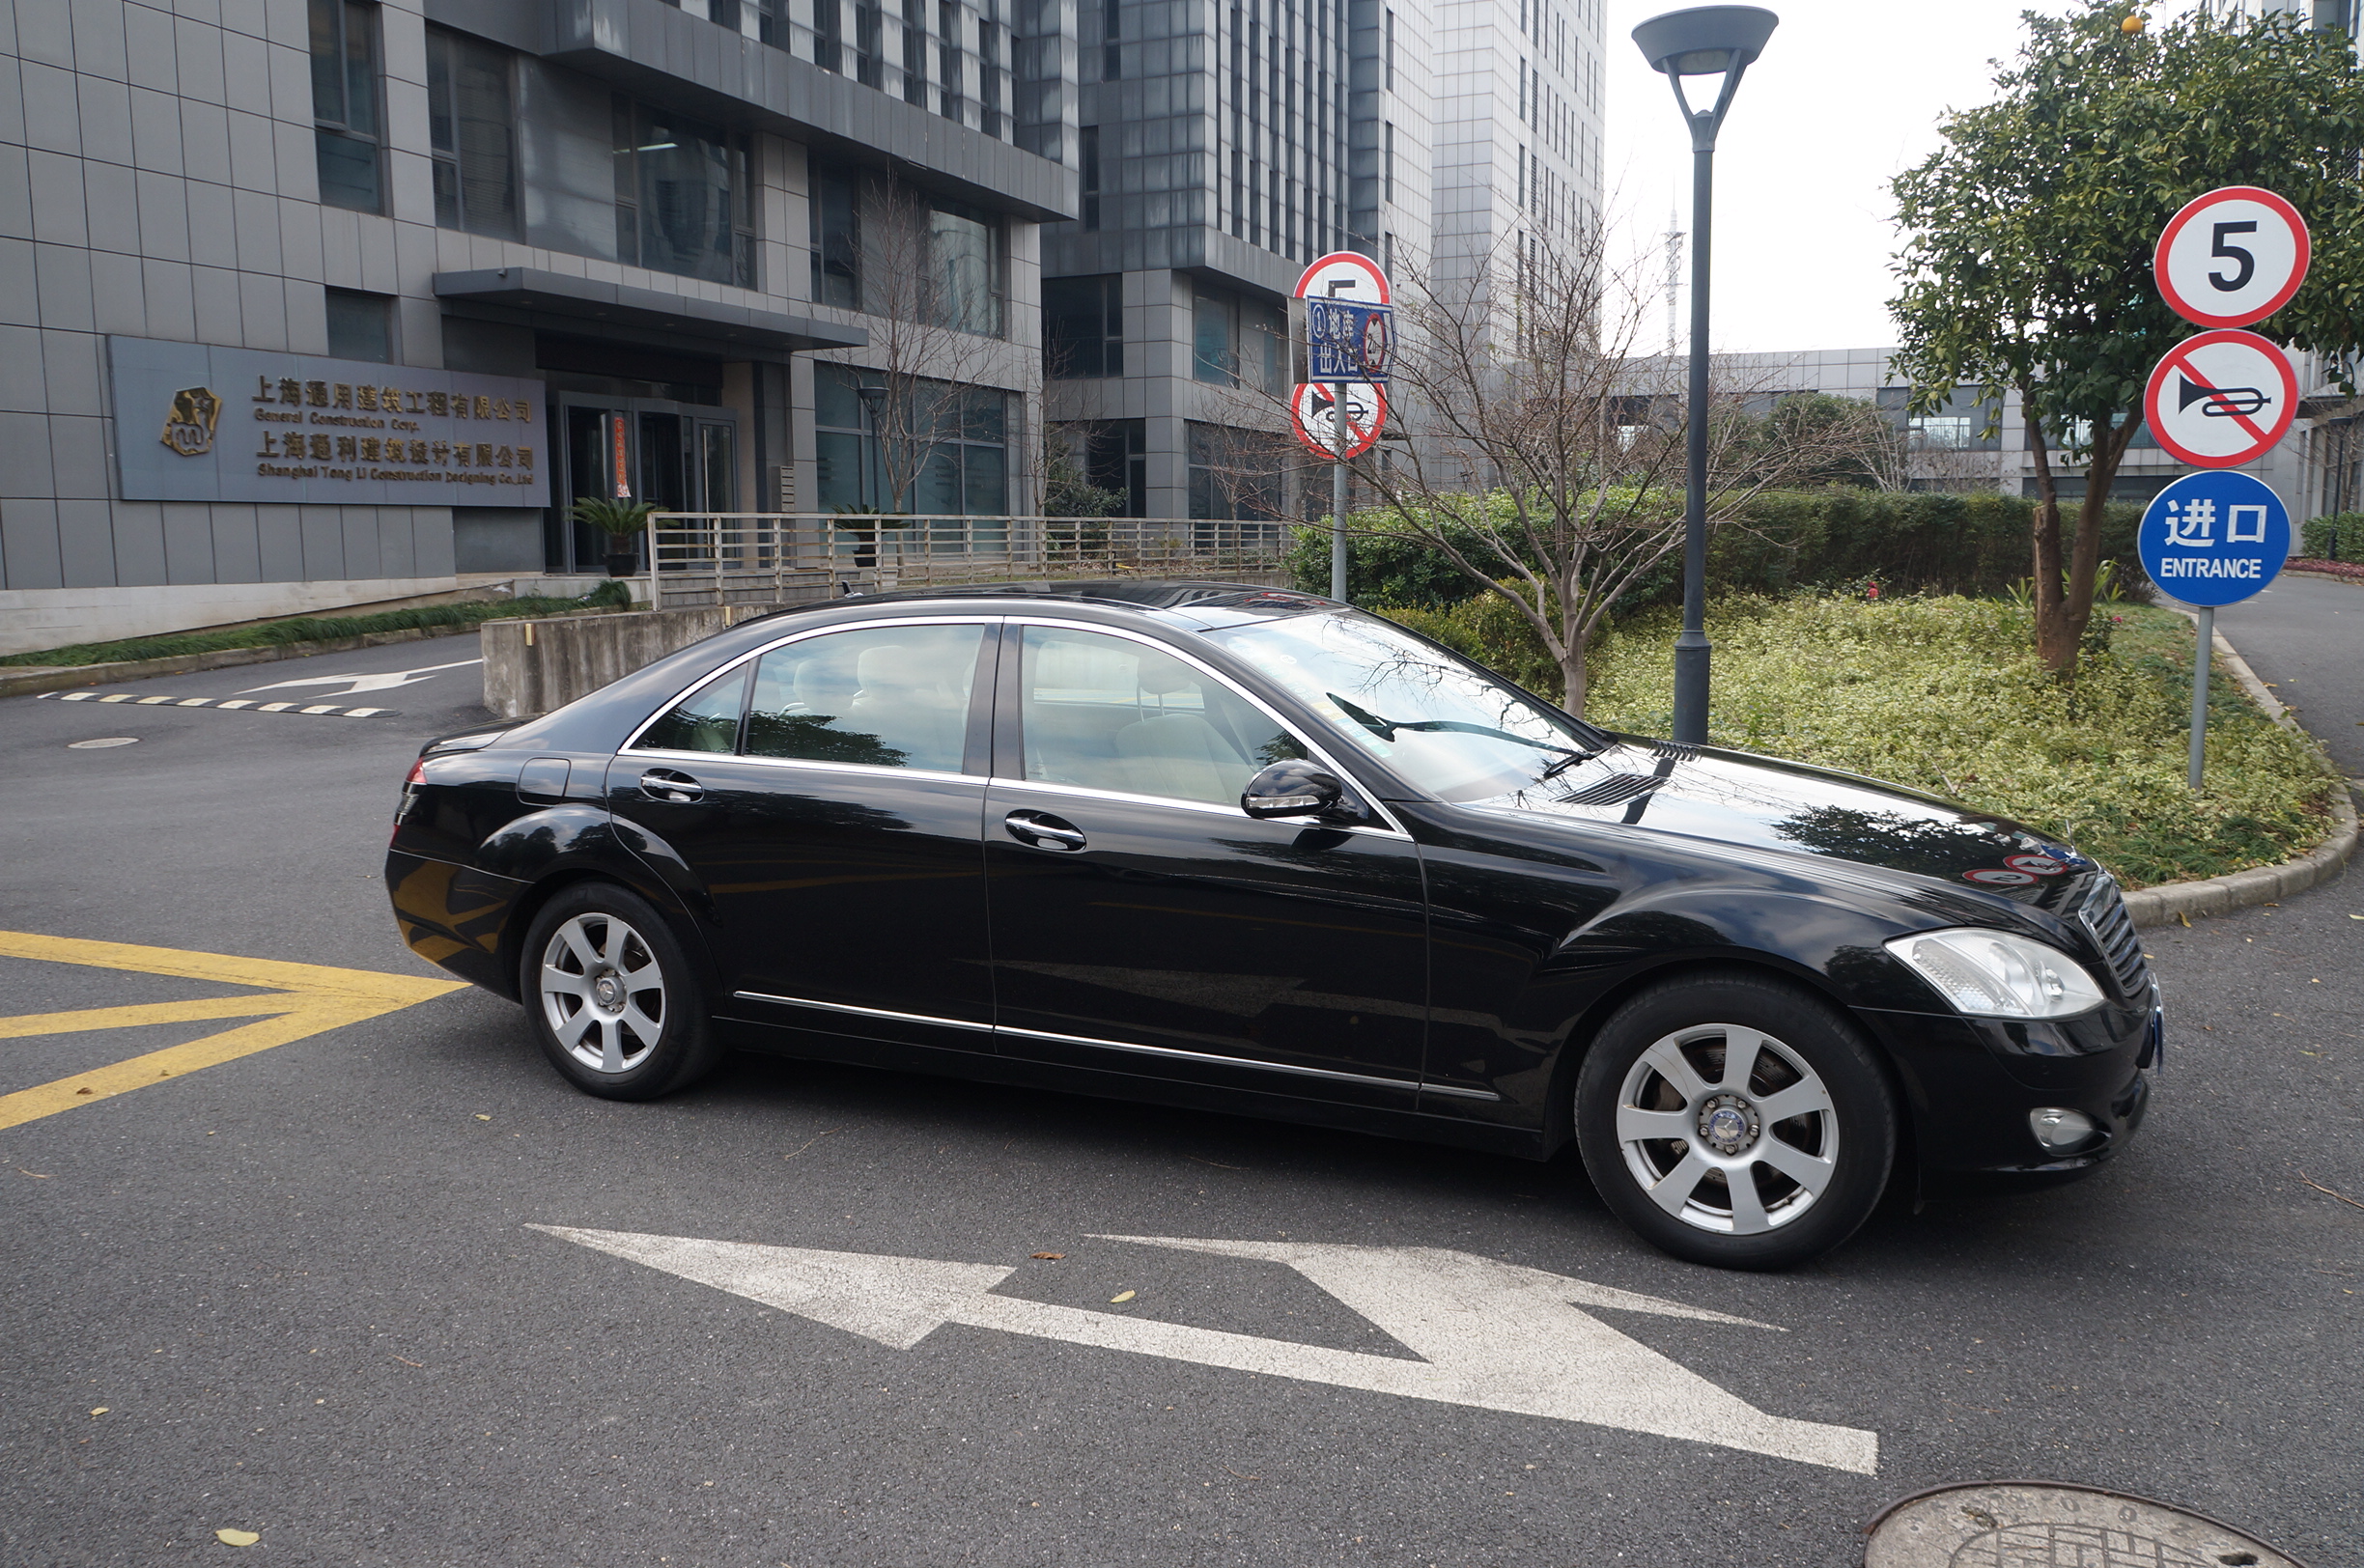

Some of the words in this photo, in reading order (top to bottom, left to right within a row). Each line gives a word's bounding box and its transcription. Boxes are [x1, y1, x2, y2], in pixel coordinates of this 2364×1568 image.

[2208, 220, 2257, 292] 5
[252, 375, 531, 423] 上海通用建筑工程有限公司
[254, 407, 302, 424] General
[310, 411, 385, 429] Construction
[391, 416, 420, 433] Corp.
[258, 463, 318, 480] Shanghai
[320, 465, 352, 481] Tong
[371, 467, 442, 482] Construction
[445, 470, 496, 486] Designing
[2164, 498, 2266, 546] 进口
[2160, 557, 2263, 578] ENTRANCE
